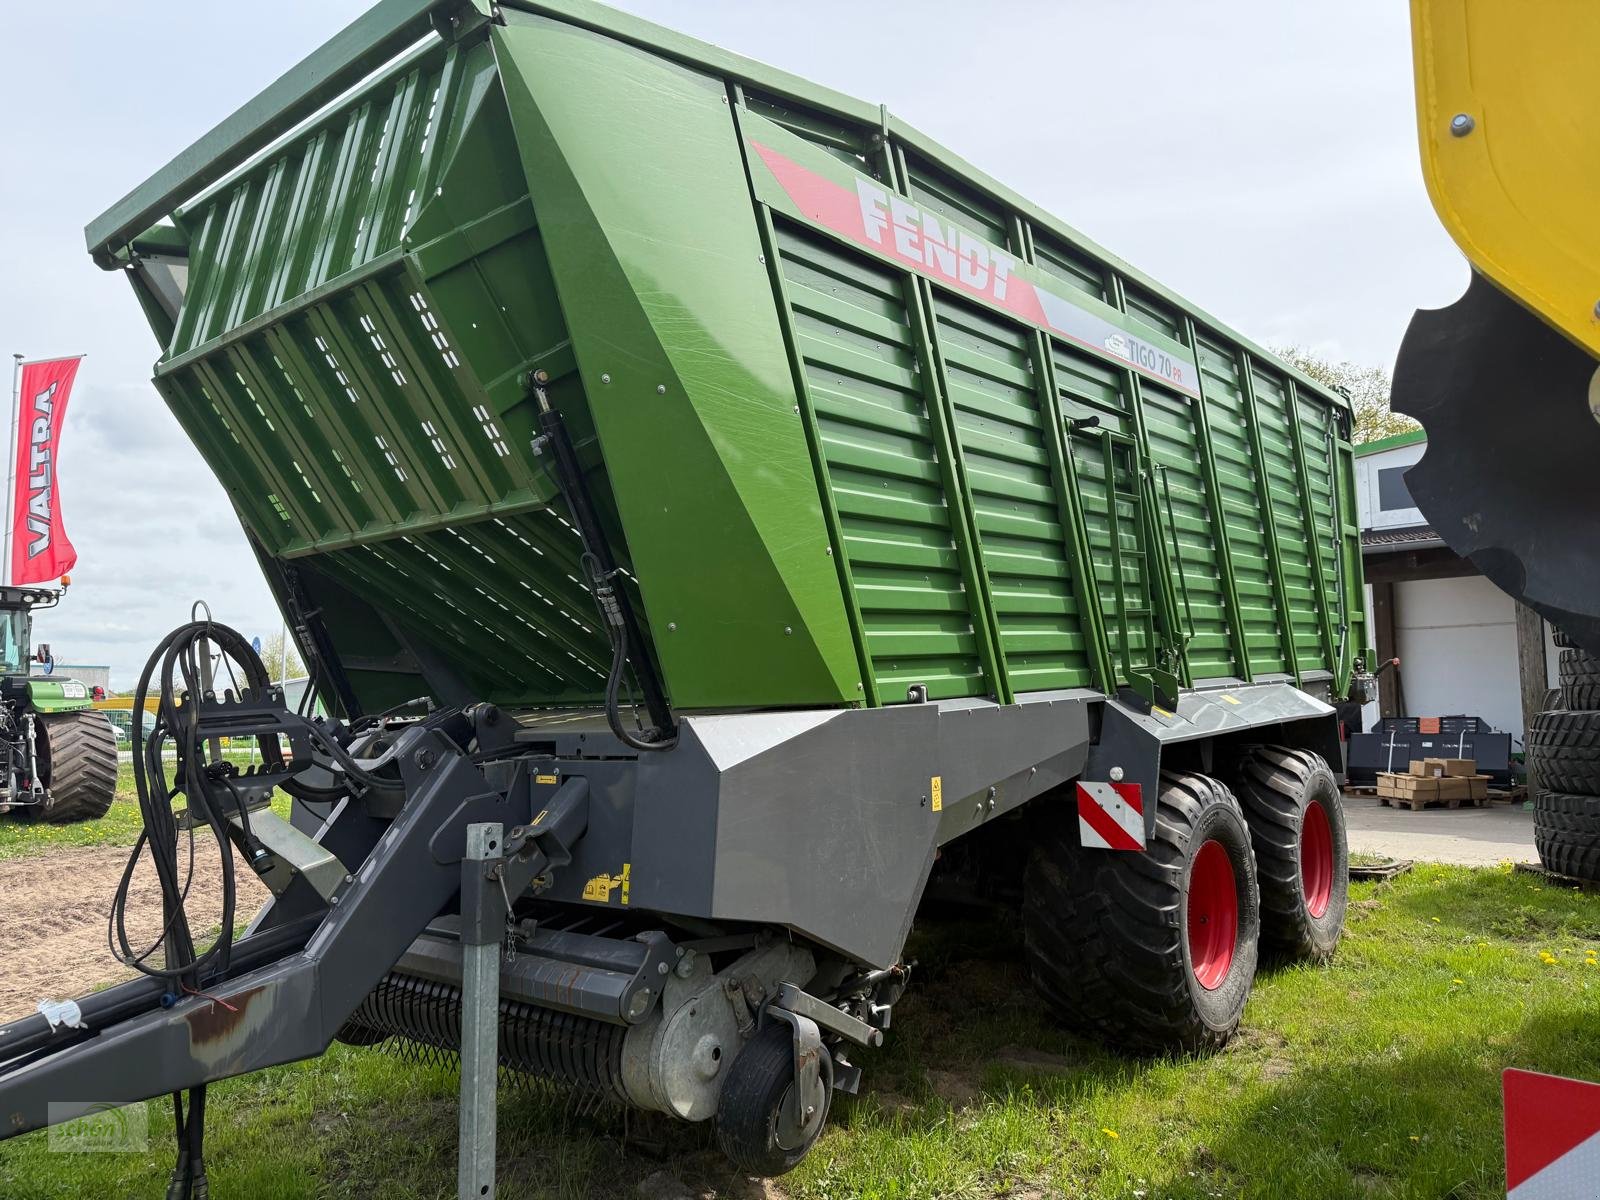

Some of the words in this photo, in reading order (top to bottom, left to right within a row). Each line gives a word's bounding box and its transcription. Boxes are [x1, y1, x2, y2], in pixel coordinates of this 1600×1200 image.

[855, 177, 1016, 301] FENDT
[1128, 338, 1156, 371] TIGO
[1158, 354, 1172, 378] 70
[1172, 366, 1182, 383] PR
[27, 381, 59, 560] VALTRA
